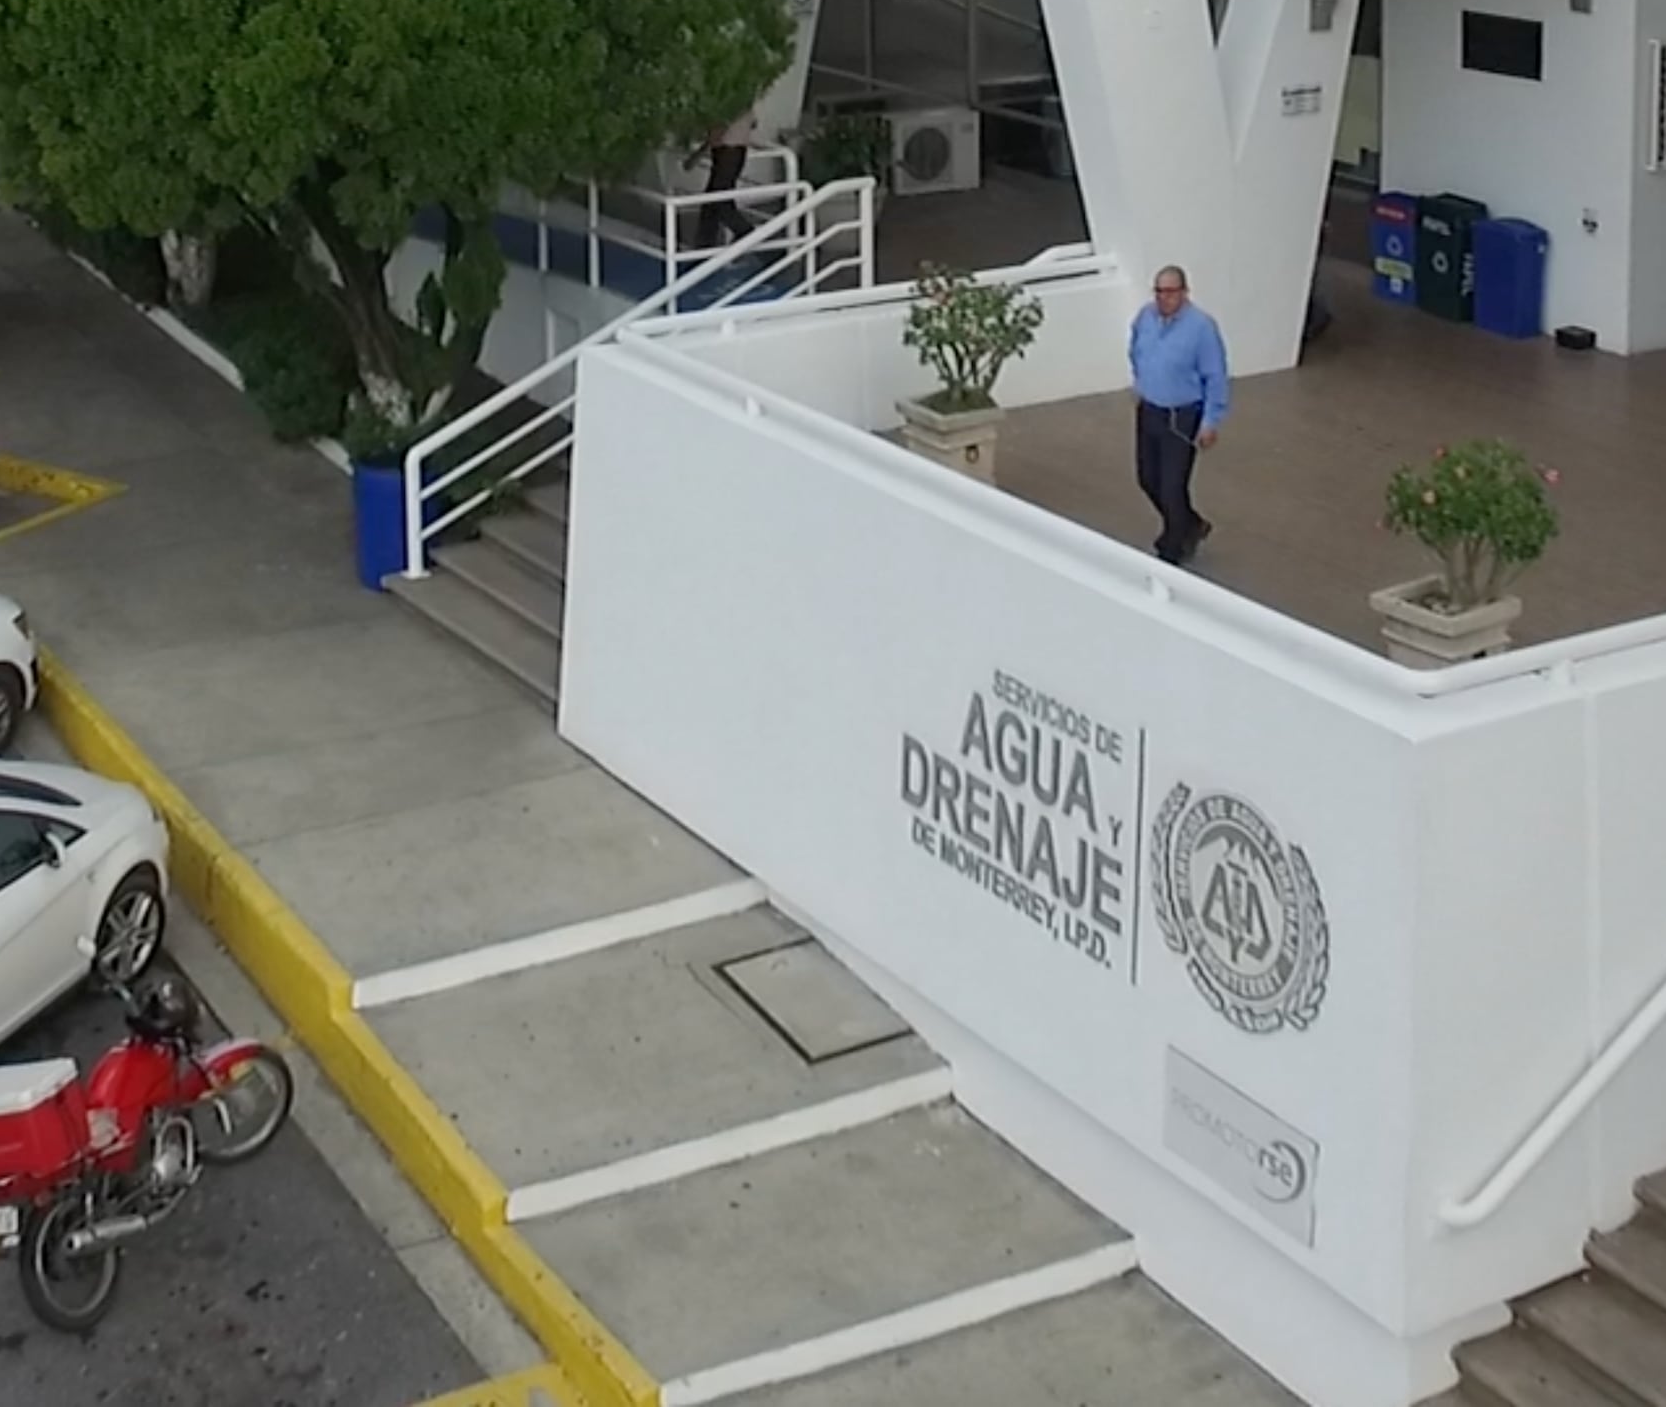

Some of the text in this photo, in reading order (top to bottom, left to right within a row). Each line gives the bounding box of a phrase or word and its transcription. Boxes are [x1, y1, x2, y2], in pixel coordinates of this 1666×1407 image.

[960, 690, 1124, 848] AGUA Y
[992, 668, 1123, 765] SERVICIOS DE
[899, 731, 1124, 936] DRENAJE
[911, 814, 936, 855] DE
[938, 831, 1060, 941] MONTERREY,
